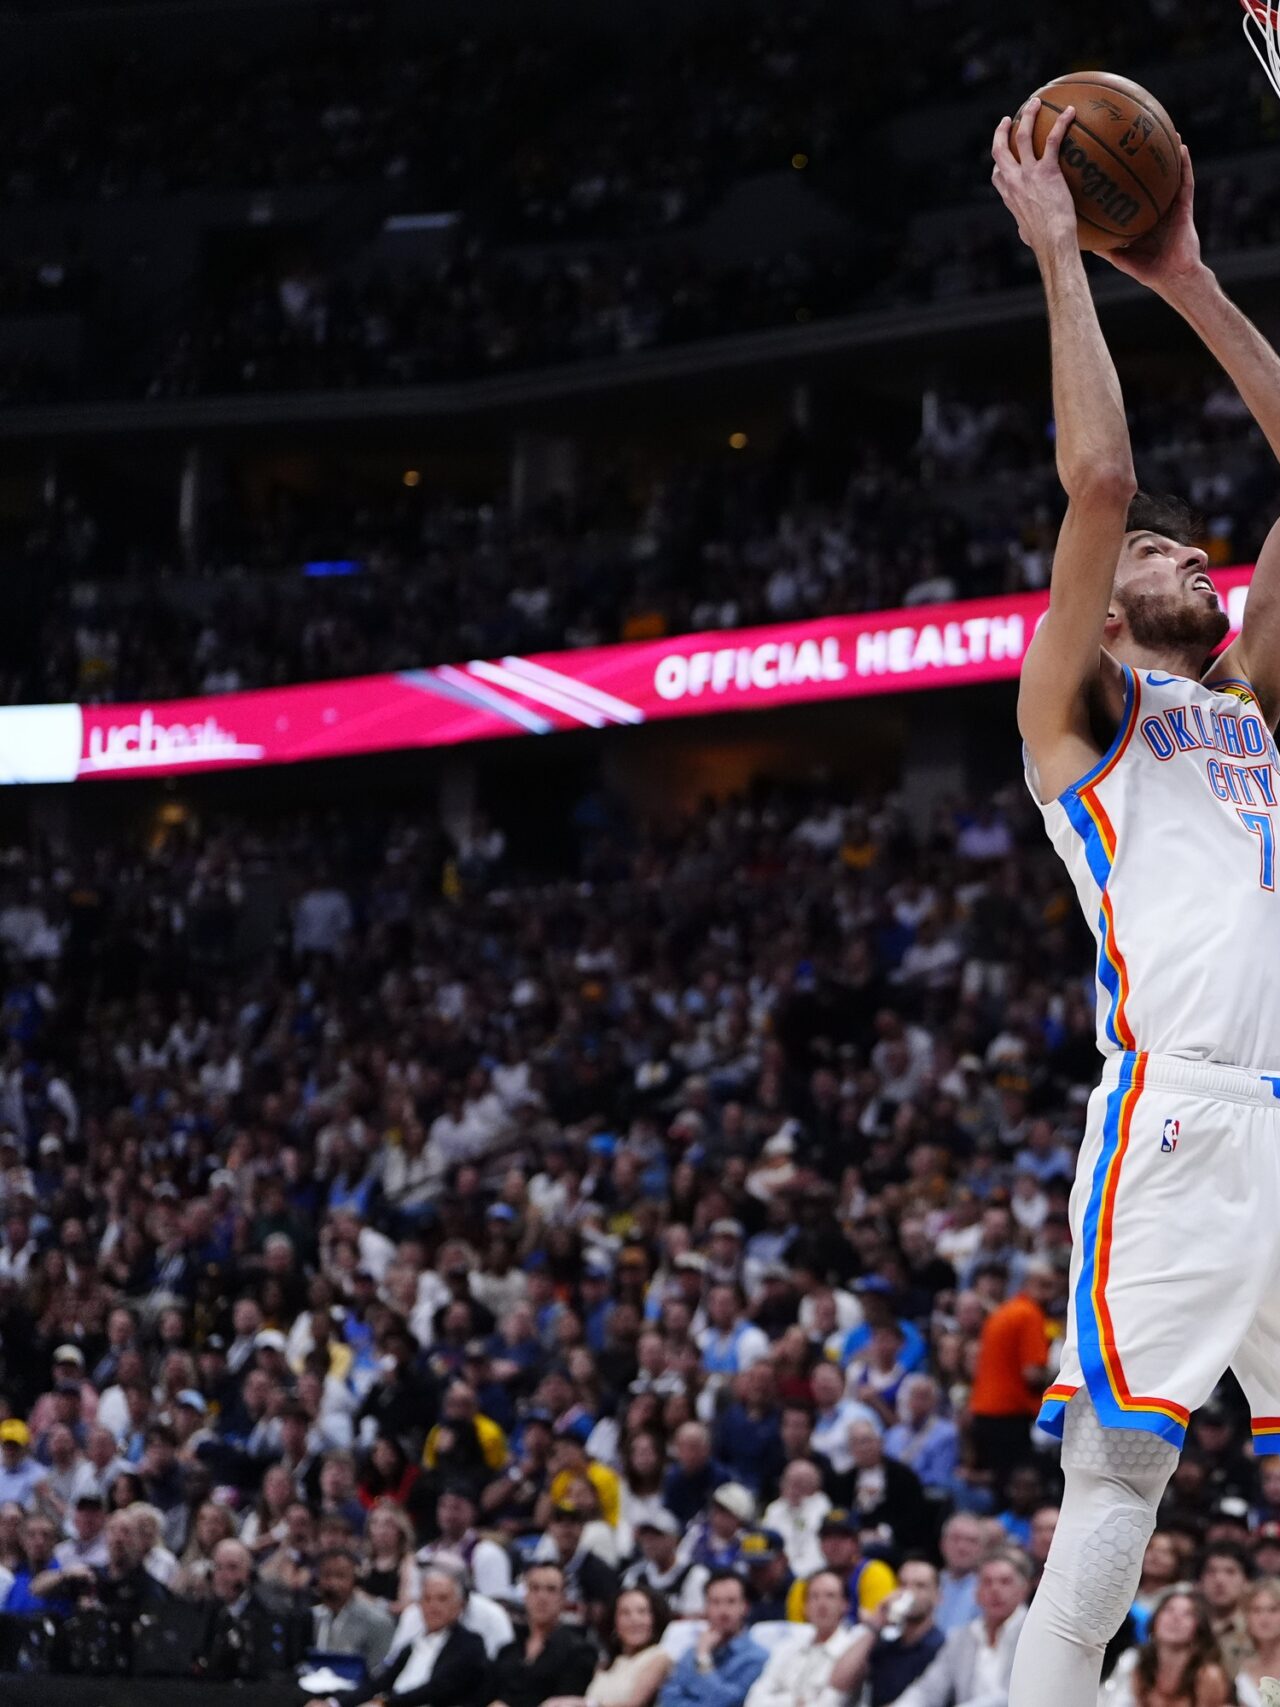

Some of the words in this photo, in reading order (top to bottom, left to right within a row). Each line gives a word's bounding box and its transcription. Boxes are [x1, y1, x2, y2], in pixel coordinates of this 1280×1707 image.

[655, 637, 847, 700] OFFICIAL
[856, 613, 1024, 677] HEALTH
[1207, 758, 1278, 807] CITY
[1236, 808, 1275, 893] 7
